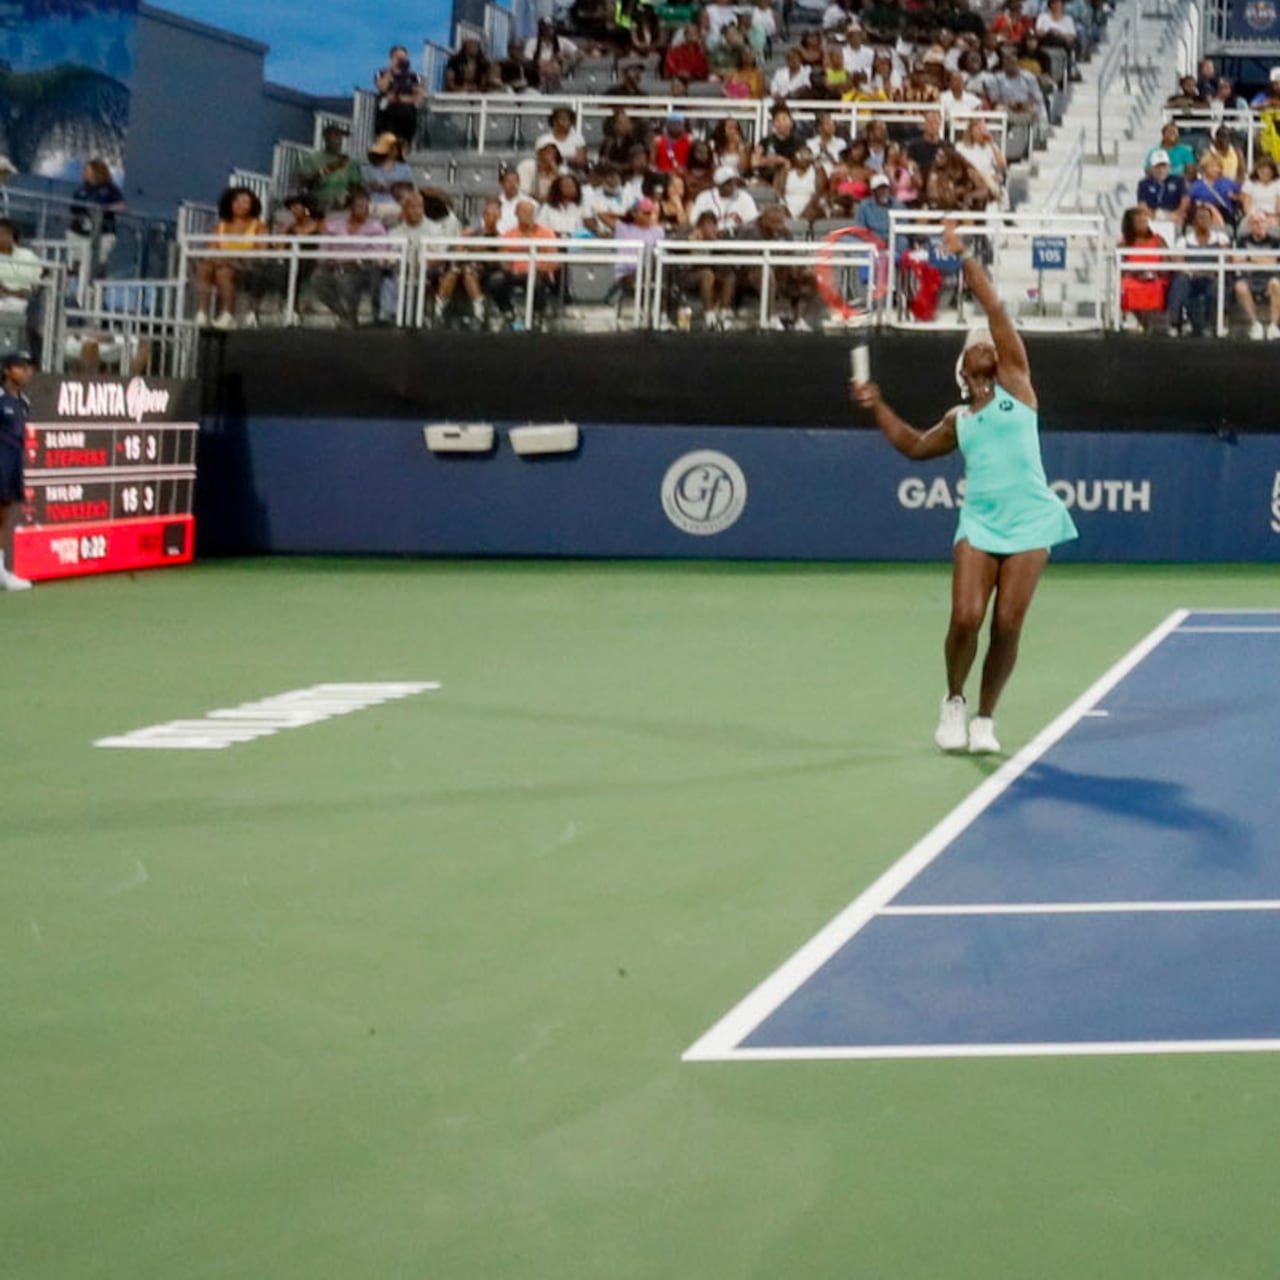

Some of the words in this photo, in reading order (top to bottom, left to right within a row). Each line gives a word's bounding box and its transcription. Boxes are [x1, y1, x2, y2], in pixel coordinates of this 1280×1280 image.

[58, 381, 125, 416] ATLANTA
[125, 435, 141, 460] 15
[146, 435, 157, 460] 3
[122, 487, 139, 512] 15
[143, 486, 154, 511] 3
[1047, 479, 1150, 511] OUTH
